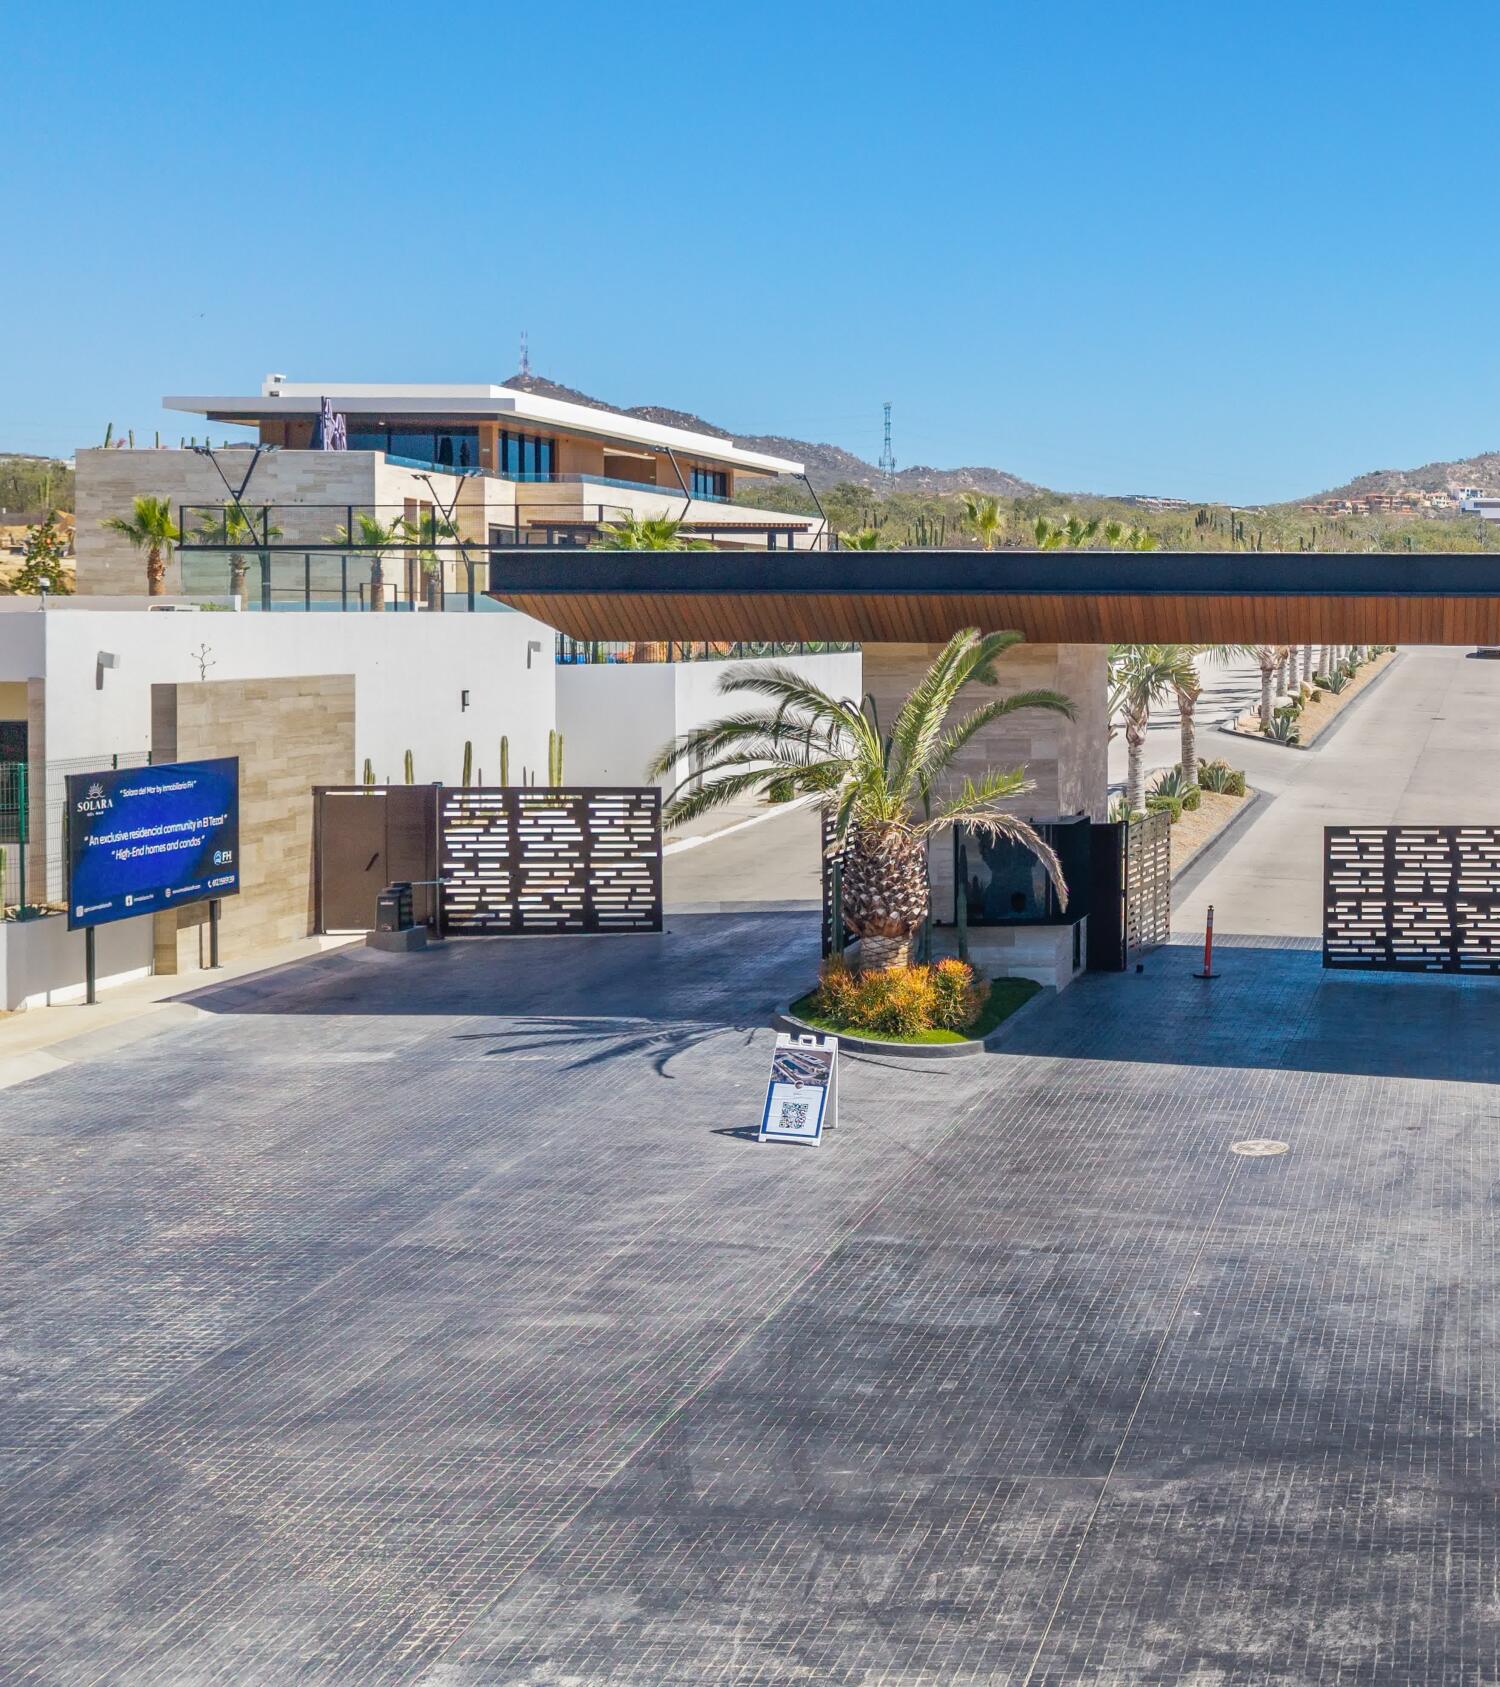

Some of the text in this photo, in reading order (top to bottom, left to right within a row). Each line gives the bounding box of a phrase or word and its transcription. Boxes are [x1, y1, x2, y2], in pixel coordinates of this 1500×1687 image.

[77, 799, 113, 812] SOLARA
[100, 830, 128, 845] exclusive
[164, 820, 196, 833] community
[197, 818, 202, 828] in
[145, 843, 166, 855] homes
[167, 839, 179, 850] and
[222, 851, 232, 861] FH
